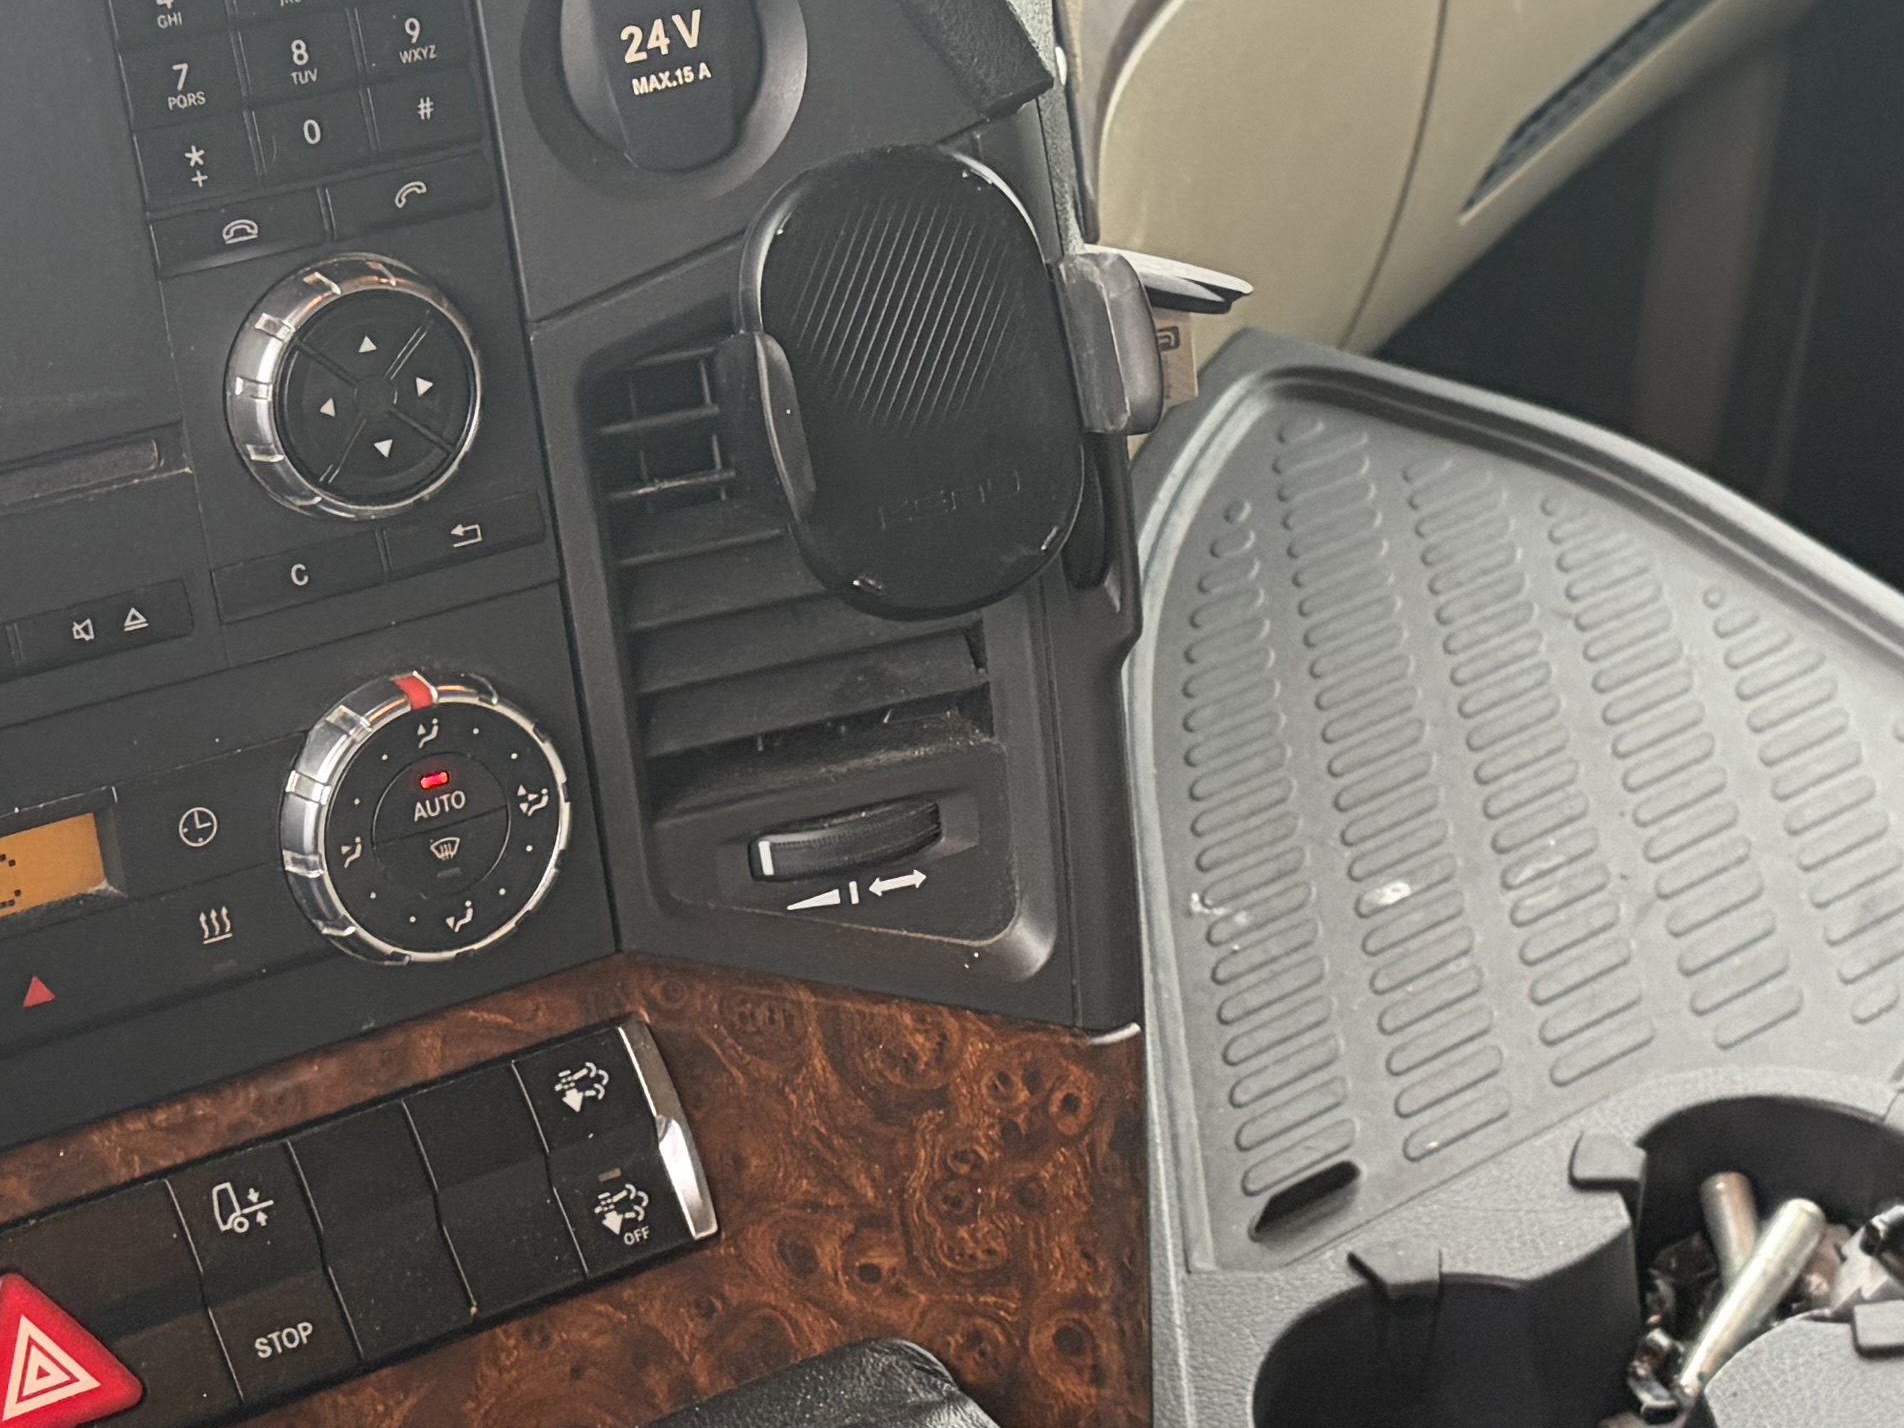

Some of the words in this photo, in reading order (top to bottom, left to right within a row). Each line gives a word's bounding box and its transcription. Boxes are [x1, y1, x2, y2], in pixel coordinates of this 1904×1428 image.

[157, 12, 183, 29] GHI
[404, 17, 421, 44] 9
[291, 39, 309, 66] 8
[399, 44, 437, 64] WXYZ
[172, 63, 189, 91] 7
[291, 68, 318, 85] TUV
[699, 62, 712, 80] A
[168, 91, 206, 110] PQRS
[303, 119, 321, 145] 0
[291, 564, 309, 586] C
[414, 790, 466, 822] AUTO
[623, 1225, 650, 1246] OFF
[254, 1321, 314, 1359] STOP
